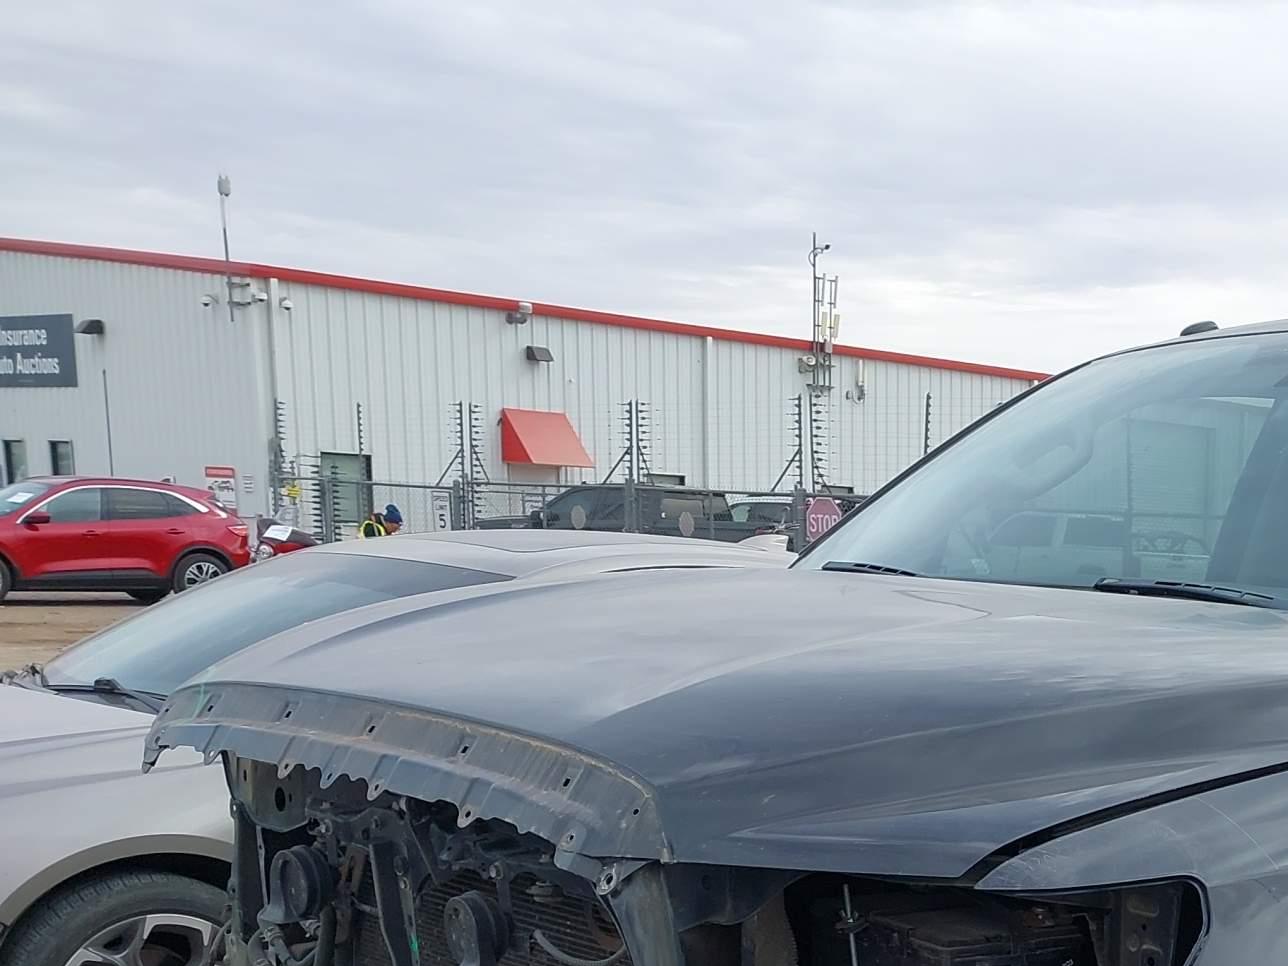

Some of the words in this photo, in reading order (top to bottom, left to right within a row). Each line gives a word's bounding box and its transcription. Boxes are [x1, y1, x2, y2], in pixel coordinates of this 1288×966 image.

[0, 328, 47, 346] nsurance
[0, 355, 14, 374] uto
[16, 352, 60, 374] Auctions
[439, 513, 447, 528] 5
[810, 514, 839, 532] STOP
